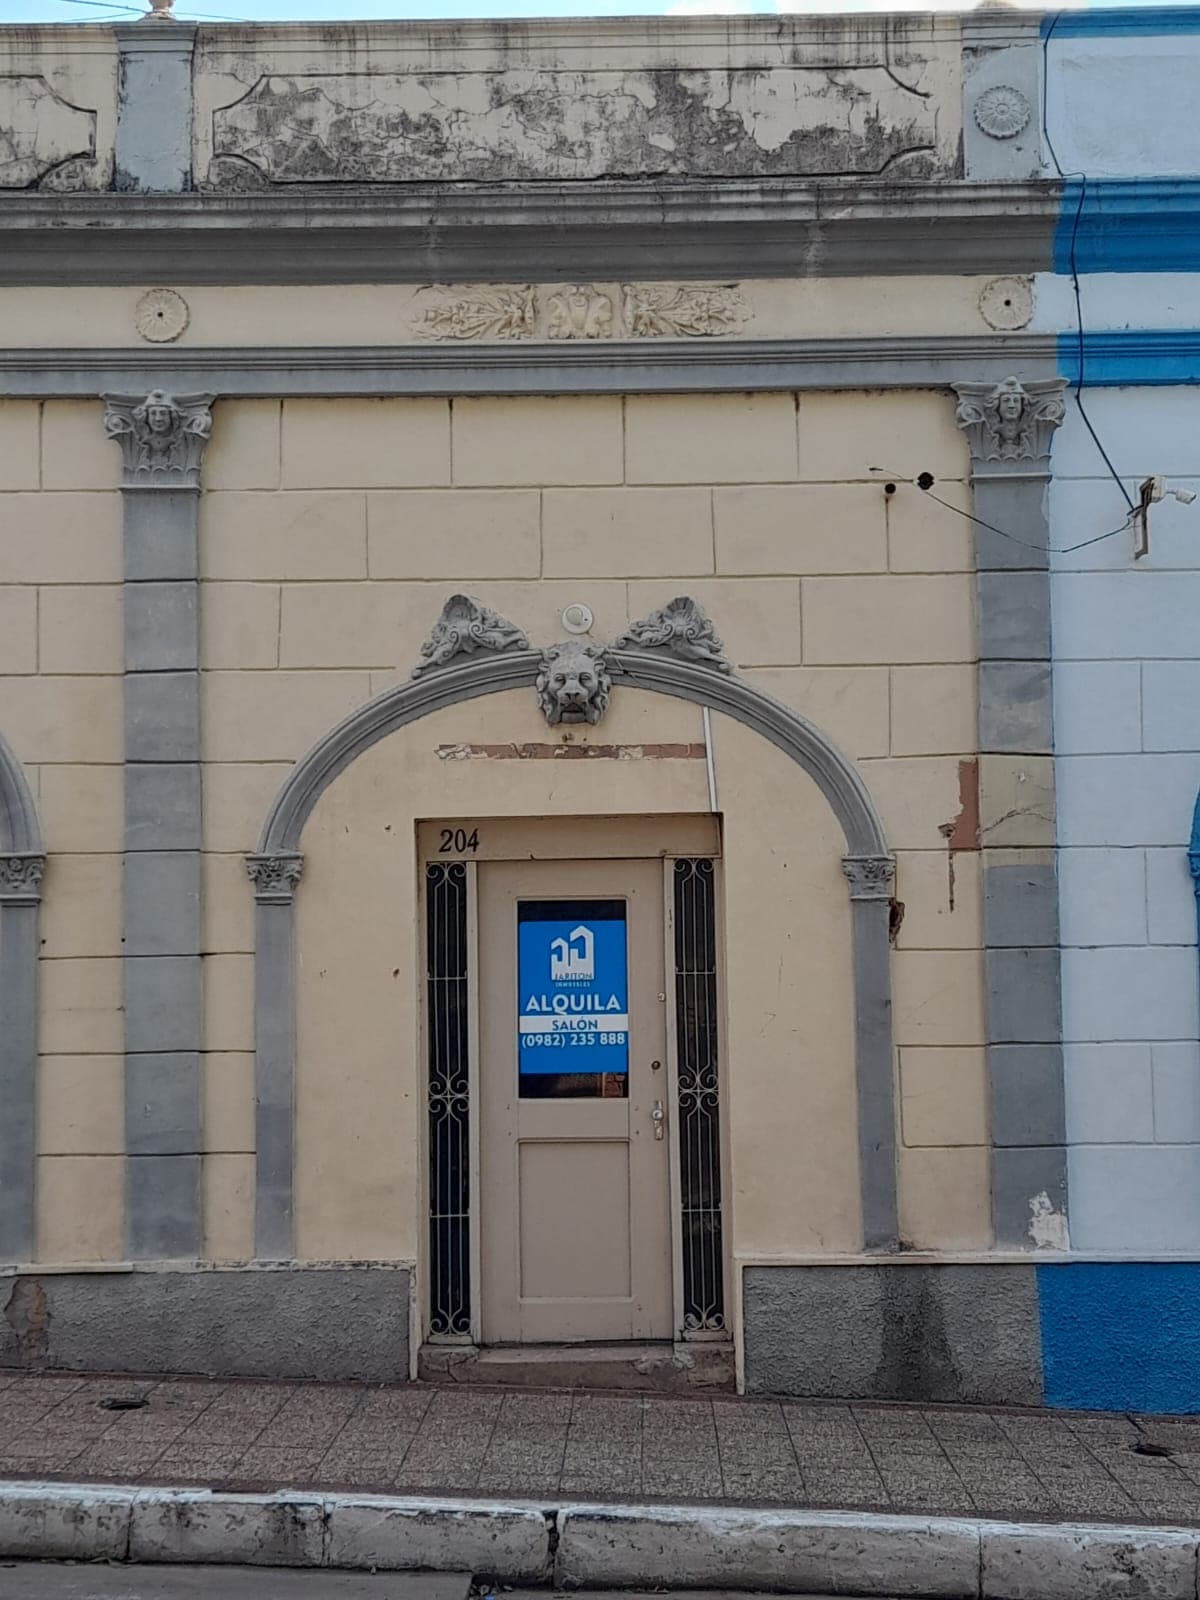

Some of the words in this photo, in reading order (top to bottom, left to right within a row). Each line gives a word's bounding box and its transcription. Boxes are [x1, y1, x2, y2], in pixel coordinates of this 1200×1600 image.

[438, 828, 480, 853] 204
[525, 994, 621, 1015] ALQUILA
[552, 1016, 598, 1031] SALÓN
[521, 1034, 566, 1048] (0982)
[570, 1034, 595, 1046] 235
[600, 1033, 625, 1045] 888
